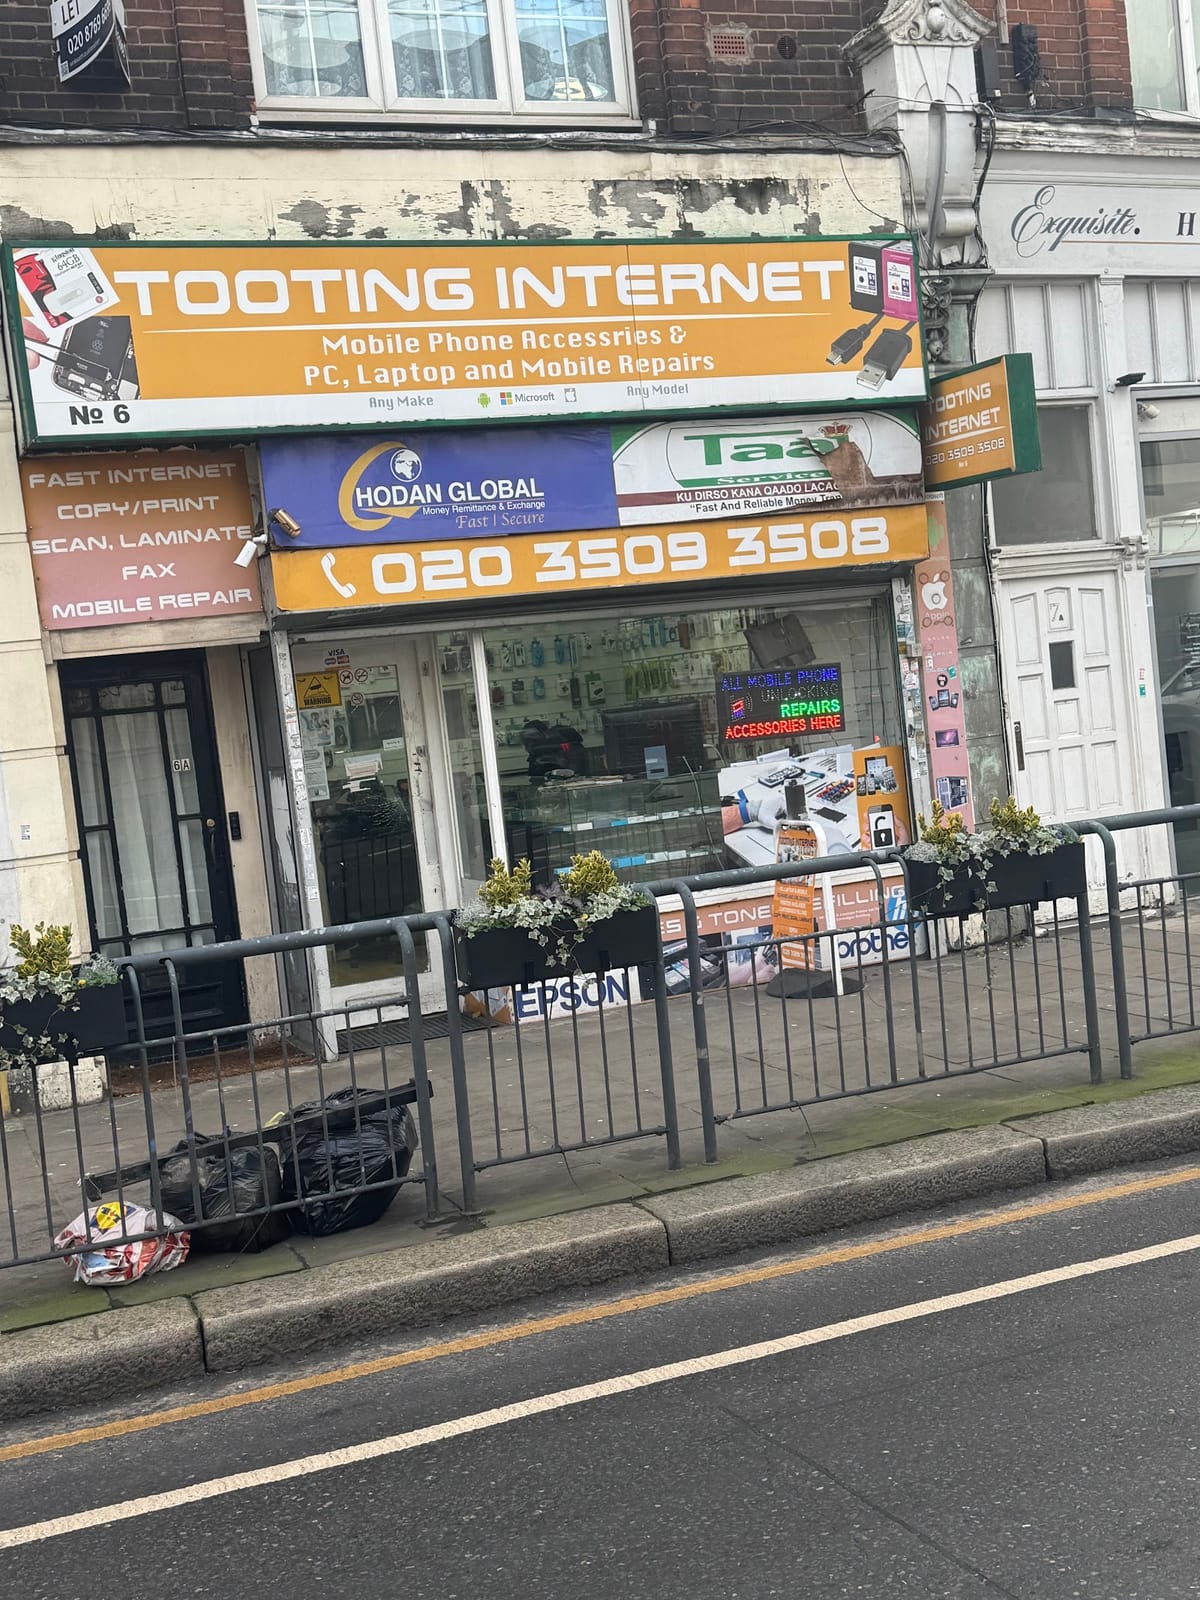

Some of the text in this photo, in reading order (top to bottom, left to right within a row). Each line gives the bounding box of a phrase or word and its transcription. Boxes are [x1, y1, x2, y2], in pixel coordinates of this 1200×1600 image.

[67, 31, 84, 55] 020
[84, 14, 101, 43] 8769
[1010, 184, 1141, 259] Exquisite.
[57, 253, 81, 272] 64GB
[114, 267, 474, 316] TOOTING
[495, 260, 845, 310] INTERNET
[322, 325, 687, 356] Mobile Phone Accessries &
[303, 353, 715, 388] PC, Laptop and Mobile Repairs
[369, 394, 434, 411] Any Make
[514, 391, 555, 403] Microsoft
[627, 383, 689, 399] Any Model
[113, 404, 130, 425] 6
[924, 406, 1001, 440] INTERNET
[925, 453, 945, 466] 020
[947, 445, 975, 461] 3509
[977, 437, 1006, 454] 3508
[28, 463, 236, 489] FAST INTERNET
[716, 471, 825, 485] Service
[355, 478, 545, 508] HODAN GLOBAL
[676, 492, 692, 502] KU
[695, 489, 729, 501] DIRSO
[731, 486, 762, 498] KANA
[764, 483, 802, 496] QAADO
[720, 500, 741, 511] And
[744, 496, 784, 509] Reliable
[57, 495, 220, 520] COPY/PRINT
[422, 501, 546, 516] Money Remittance & Exchange
[455, 512, 545, 529] Fast Secure
[31, 524, 252, 555] SCAN, LAMINATE
[370, 516, 890, 595] 020 3509 3508
[121, 562, 177, 581] FAX
[51, 588, 253, 620] MOBILE REPAIR
[328, 648, 345, 656] VISA
[721, 667, 838, 692] ALL MOBILE PHONE
[760, 683, 839, 702] UNLOCKING
[780, 699, 840, 718] REPAIRS
[725, 714, 841, 739] ACCESSORIES HERE
[708, 904, 774, 926] TONE
[517, 974, 628, 1018] EPSON
